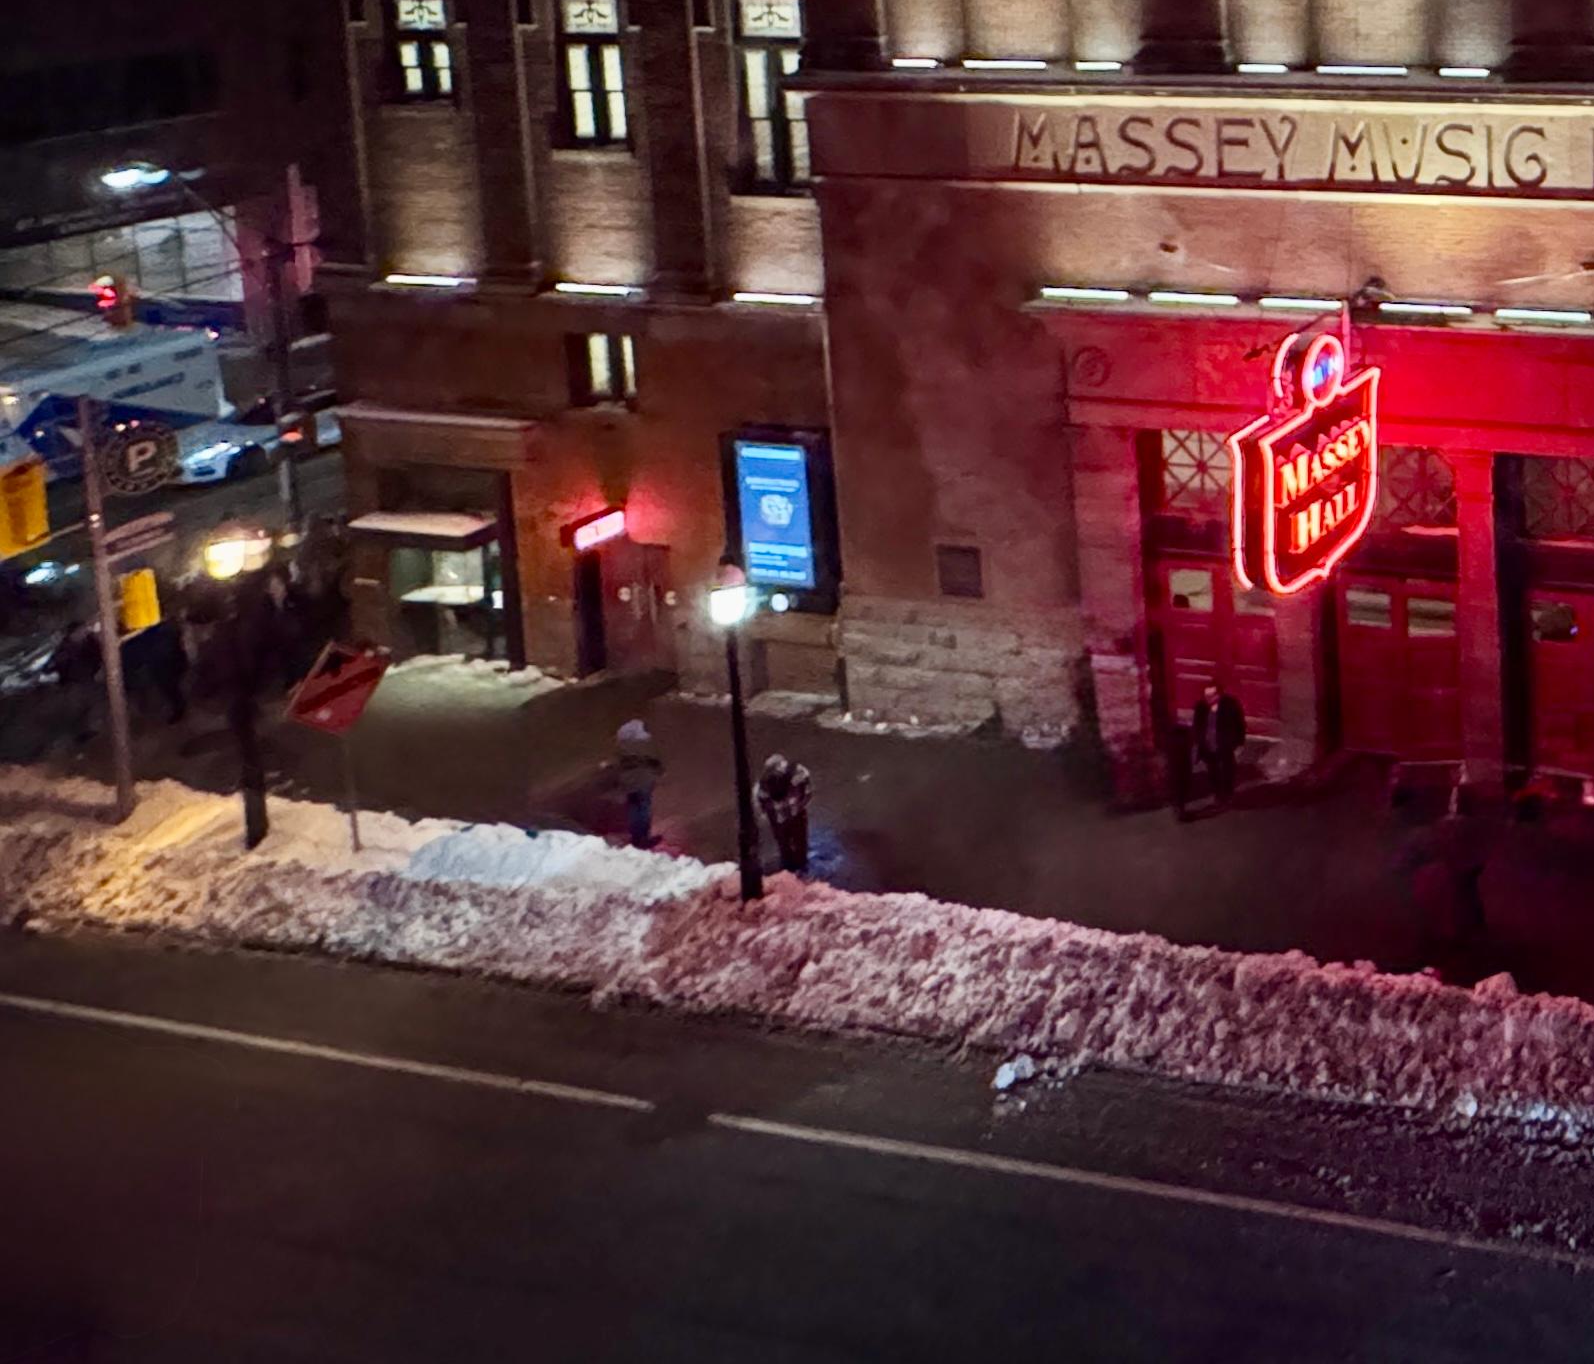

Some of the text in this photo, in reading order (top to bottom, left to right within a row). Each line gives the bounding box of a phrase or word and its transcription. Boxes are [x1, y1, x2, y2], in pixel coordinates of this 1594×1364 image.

[1013, 111, 1298, 180] MASSEY
[1274, 419, 1370, 508] MASSEY
[1289, 482, 1359, 554] HALL
